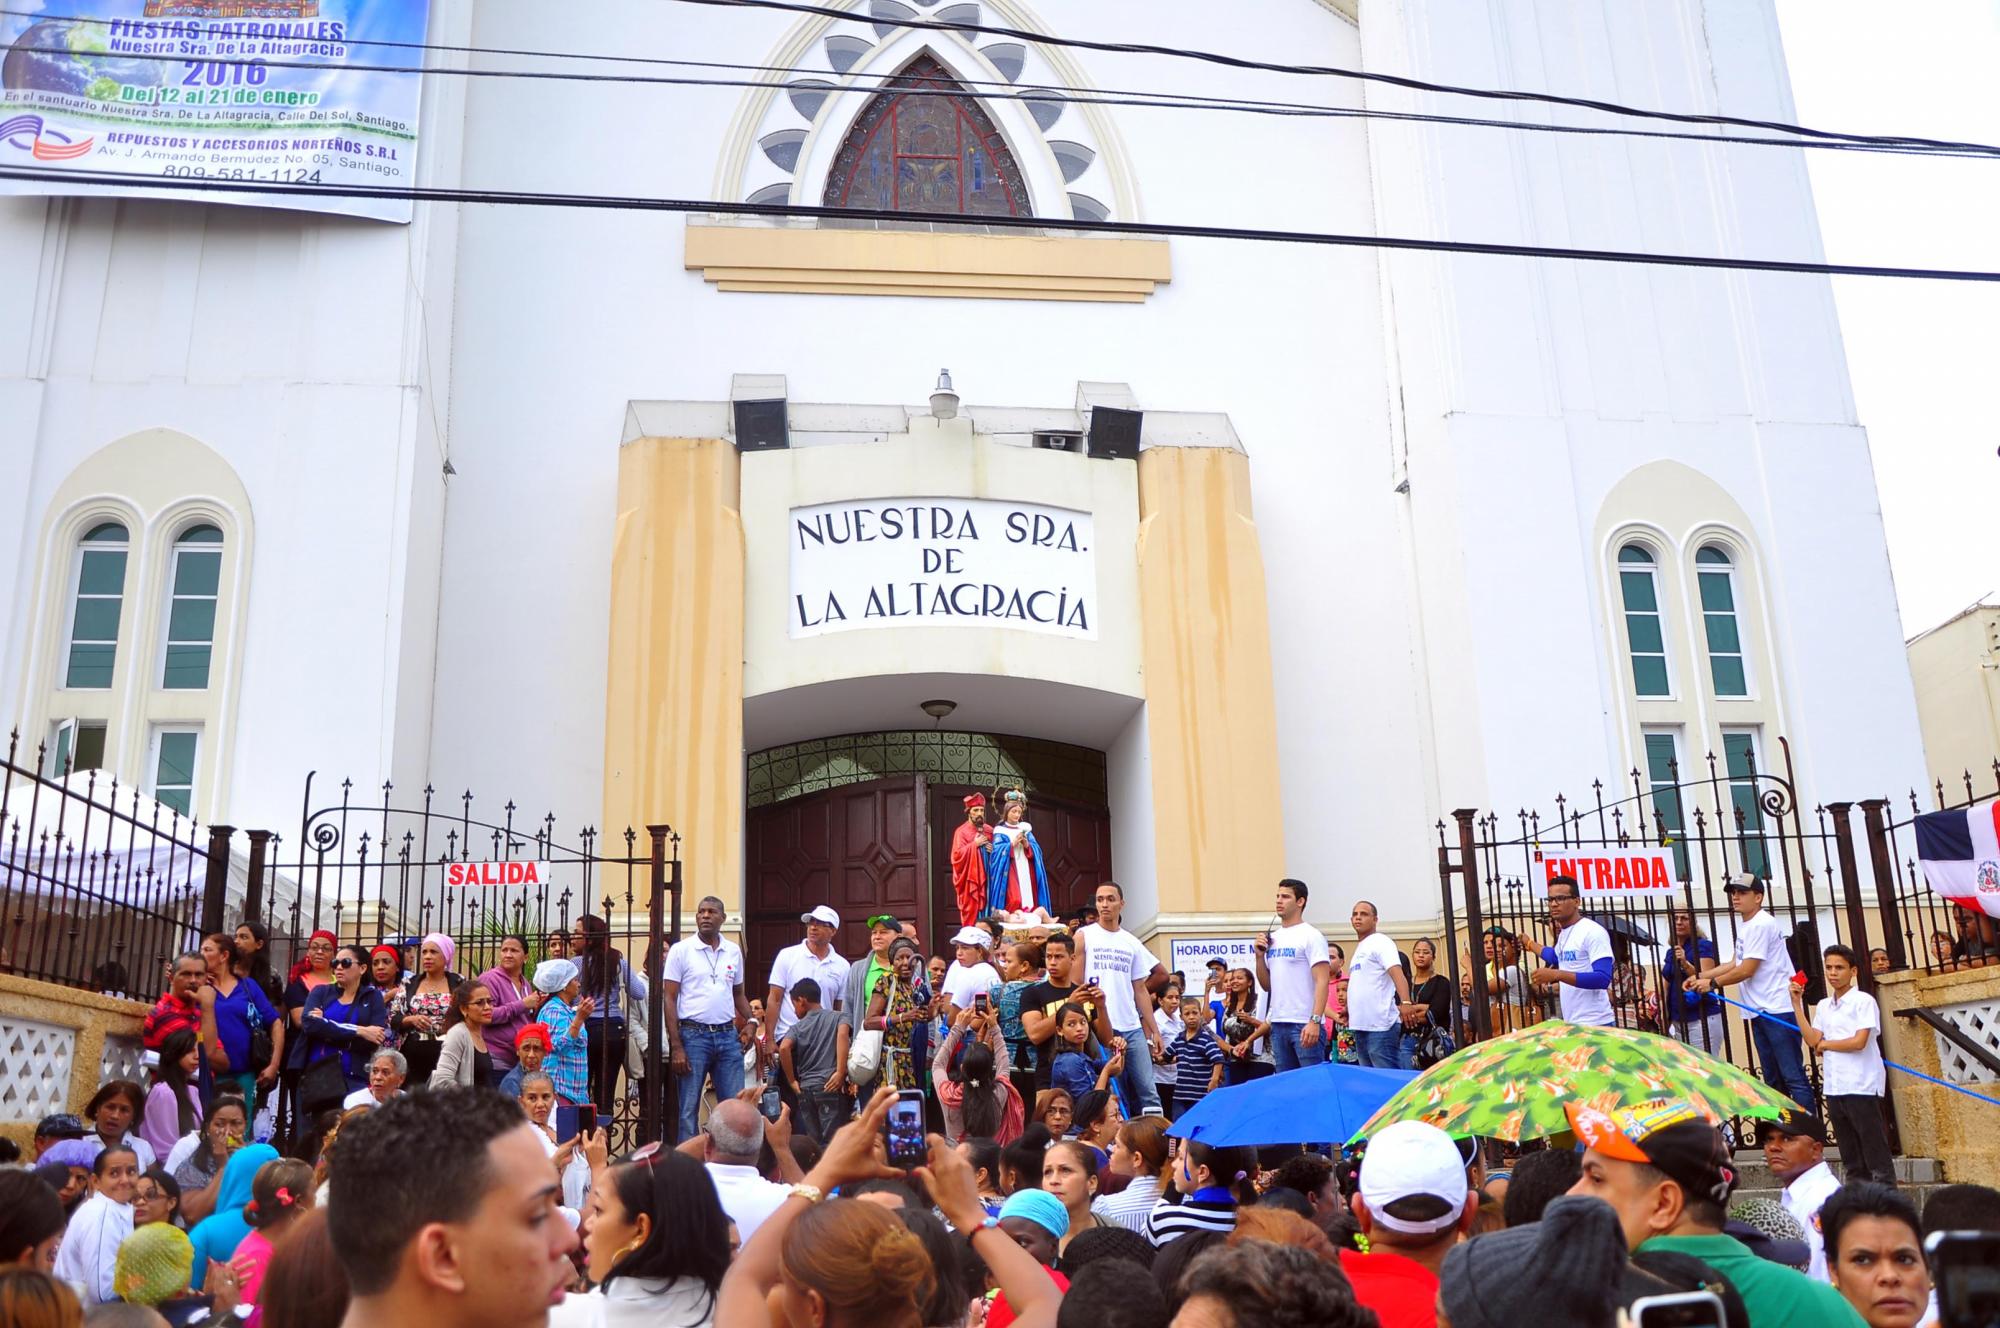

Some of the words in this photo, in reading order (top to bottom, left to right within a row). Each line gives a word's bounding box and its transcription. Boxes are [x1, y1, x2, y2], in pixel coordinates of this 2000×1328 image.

[110, 18, 200, 40] FIESTAS
[207, 21, 344, 41] PATRONALES
[110, 38, 174, 53] Nuestra
[179, 41, 211, 55] Sra.
[216, 42, 235, 54] De
[240, 43, 256, 54] La
[261, 42, 344, 57] Altagracia
[182, 58, 267, 86] 2016
[122, 86, 154, 102] Del
[160, 87, 179, 102] 12
[186, 89, 203, 104] al
[209, 89, 228, 104] 21
[234, 90, 257, 104] de
[263, 92, 319, 105] enero
[4, 91, 19, 101] En
[23, 92, 34, 100] el
[39, 94, 97, 111] santuario
[101, 104, 147, 117] Nuestra
[152, 109, 174, 119] Sra.
[178, 109, 193, 119] De
[197, 110, 210, 120] La
[213, 111, 274, 121] Altagracia,
[278, 111, 305, 121] Calle
[309, 110, 328, 120] Del
[331, 111, 351, 121] Sol,
[356, 112, 409, 131] Santiago.
[107, 132, 187, 148] REPUESTOS
[191, 138, 200, 149] Y
[203, 139, 288, 150] ACCESORIOS
[292, 137, 361, 154] NORTEÑOS
[97, 146, 118, 156] Av.
[125, 149, 137, 157] J.
[142, 150, 205, 162] Armando
[210, 153, 280, 164] Bermudez
[312, 153, 333, 167] 05,
[339, 156, 404, 177] Santiago.
[162, 165, 322, 184] 809-581-1124
[797, 507, 979, 550] NUESTRA
[1005, 511, 1088, 552] SRA.
[922, 548, 964, 574] DE
[796, 590, 847, 627] LA
[448, 861, 539, 885] SALIDA
[1545, 857, 1670, 890] ENTRADA
[1176, 945, 1227, 955] HORARIO
[1231, 944, 1246, 954] DE
